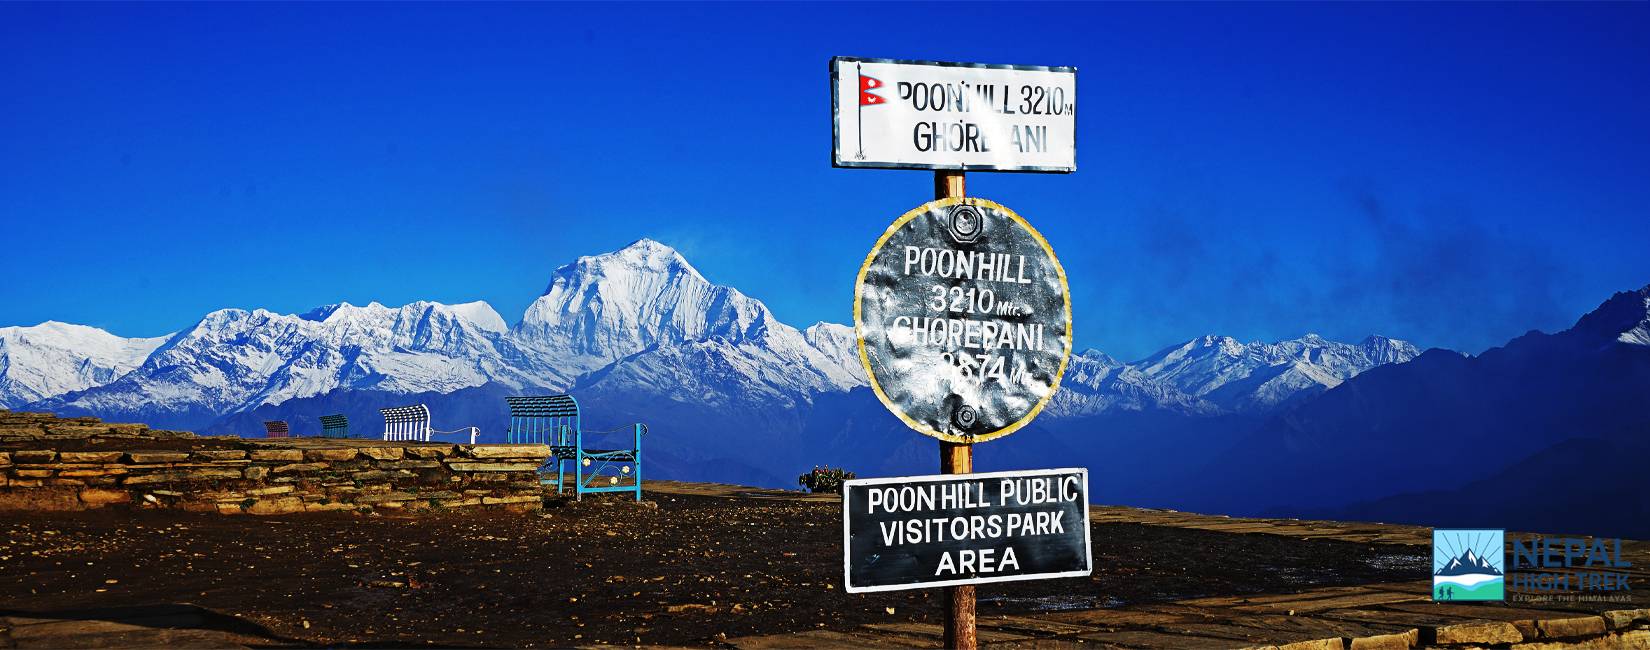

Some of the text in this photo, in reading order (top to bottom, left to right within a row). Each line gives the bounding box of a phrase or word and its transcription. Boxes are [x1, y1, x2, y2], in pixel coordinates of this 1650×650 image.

[913, 121, 1047, 152] GHORANI
[930, 285, 994, 314] 3210
[868, 476, 1078, 514] POON HILL PUBLIC
[880, 510, 1065, 547] VISITORS PARK
[934, 547, 1020, 576] AREA
